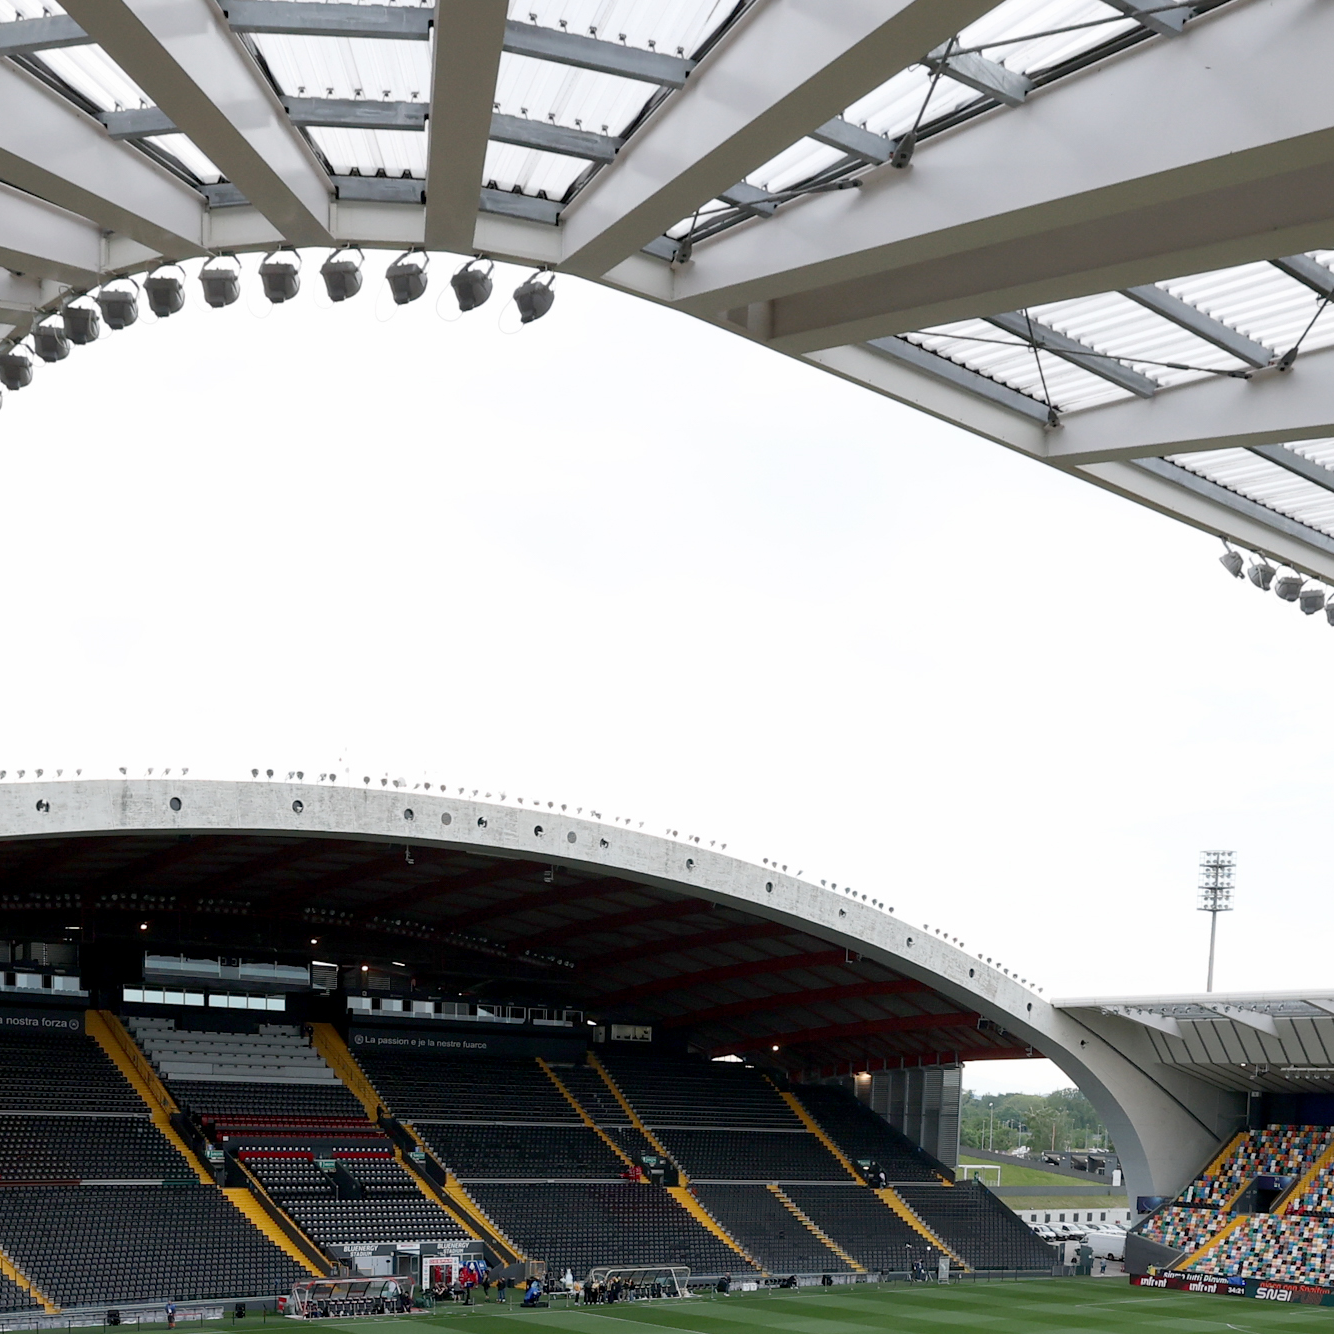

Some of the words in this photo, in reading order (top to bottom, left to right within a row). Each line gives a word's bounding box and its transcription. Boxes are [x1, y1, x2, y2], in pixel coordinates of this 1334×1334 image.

[6, 1016, 39, 1026] nostra
[41, 1018, 67, 1028] forza
[378, 1037, 409, 1046] passion
[428, 1039, 435, 1047] la
[463, 1041, 487, 1049] fuarce
[1227, 1286, 1245, 1295] 34:21
